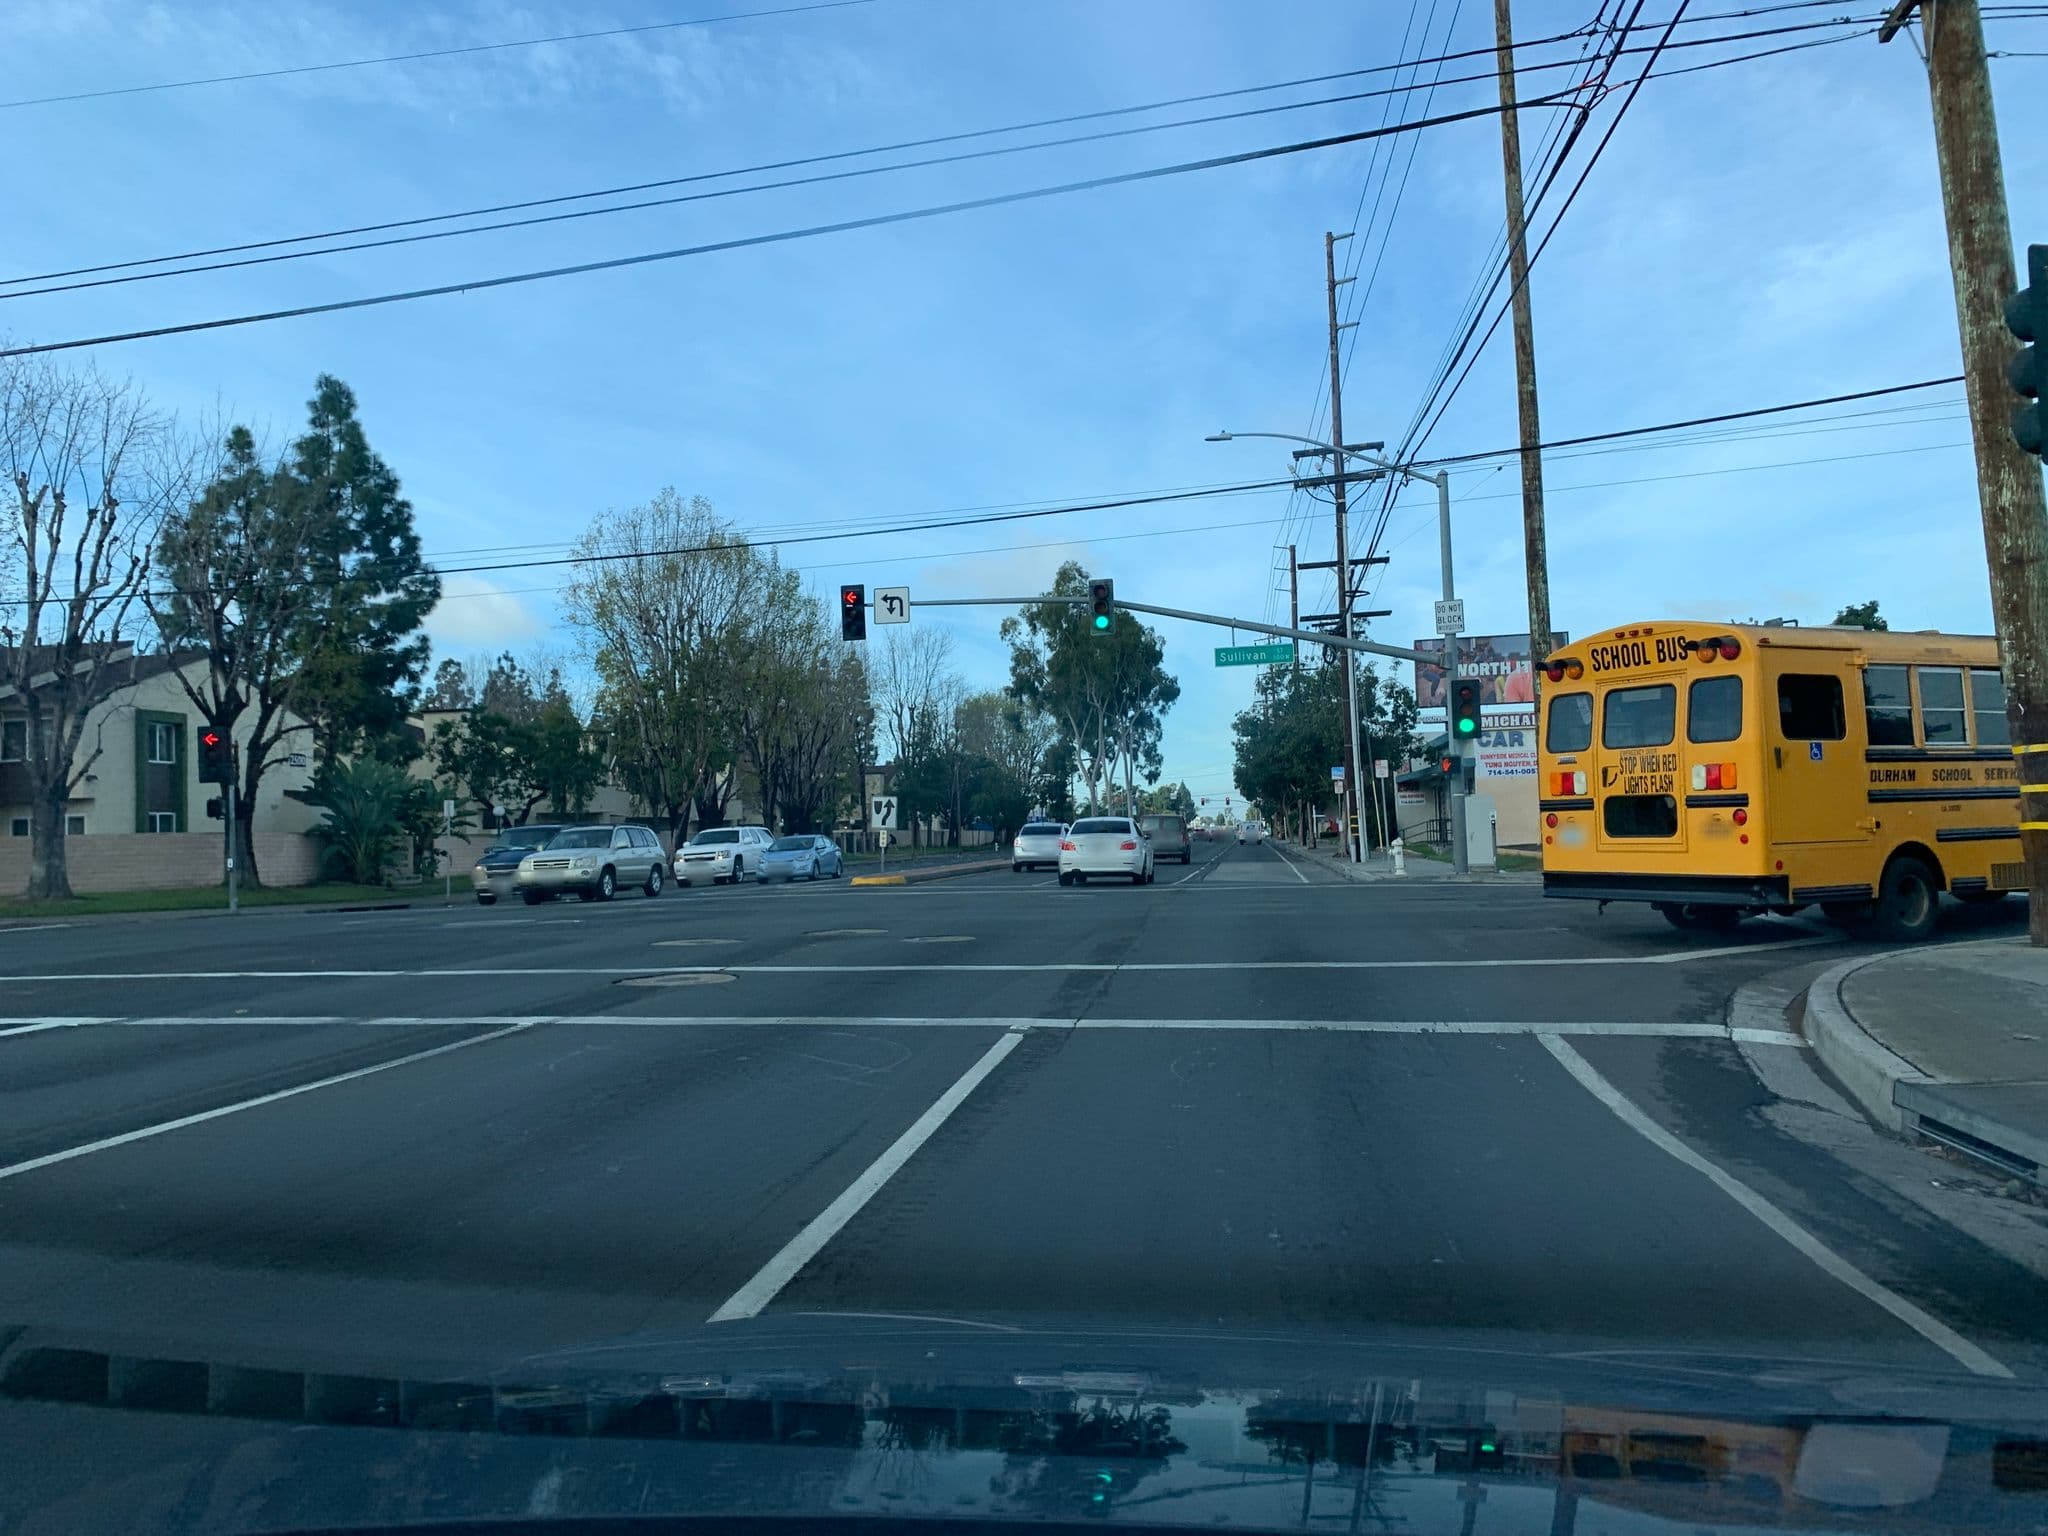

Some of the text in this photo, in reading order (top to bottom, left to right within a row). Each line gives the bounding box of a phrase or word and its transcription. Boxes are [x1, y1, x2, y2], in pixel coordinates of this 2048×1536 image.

[1437, 603, 1461, 613] DO NOT
[1437, 615, 1462, 624] BLOCK
[1219, 651, 1266, 663] Sullivan
[1591, 635, 1688, 672] SCHOOL BUS
[1457, 661, 1511, 677] NORTH
[1477, 731, 1524, 748] CAR
[1619, 753, 1677, 775] STOP WHEN RED
[1869, 769, 1916, 782] DURHAM
[1932, 768, 1973, 781] SCHOOL
[1624, 774, 1673, 794] LIGHTS FLASH
